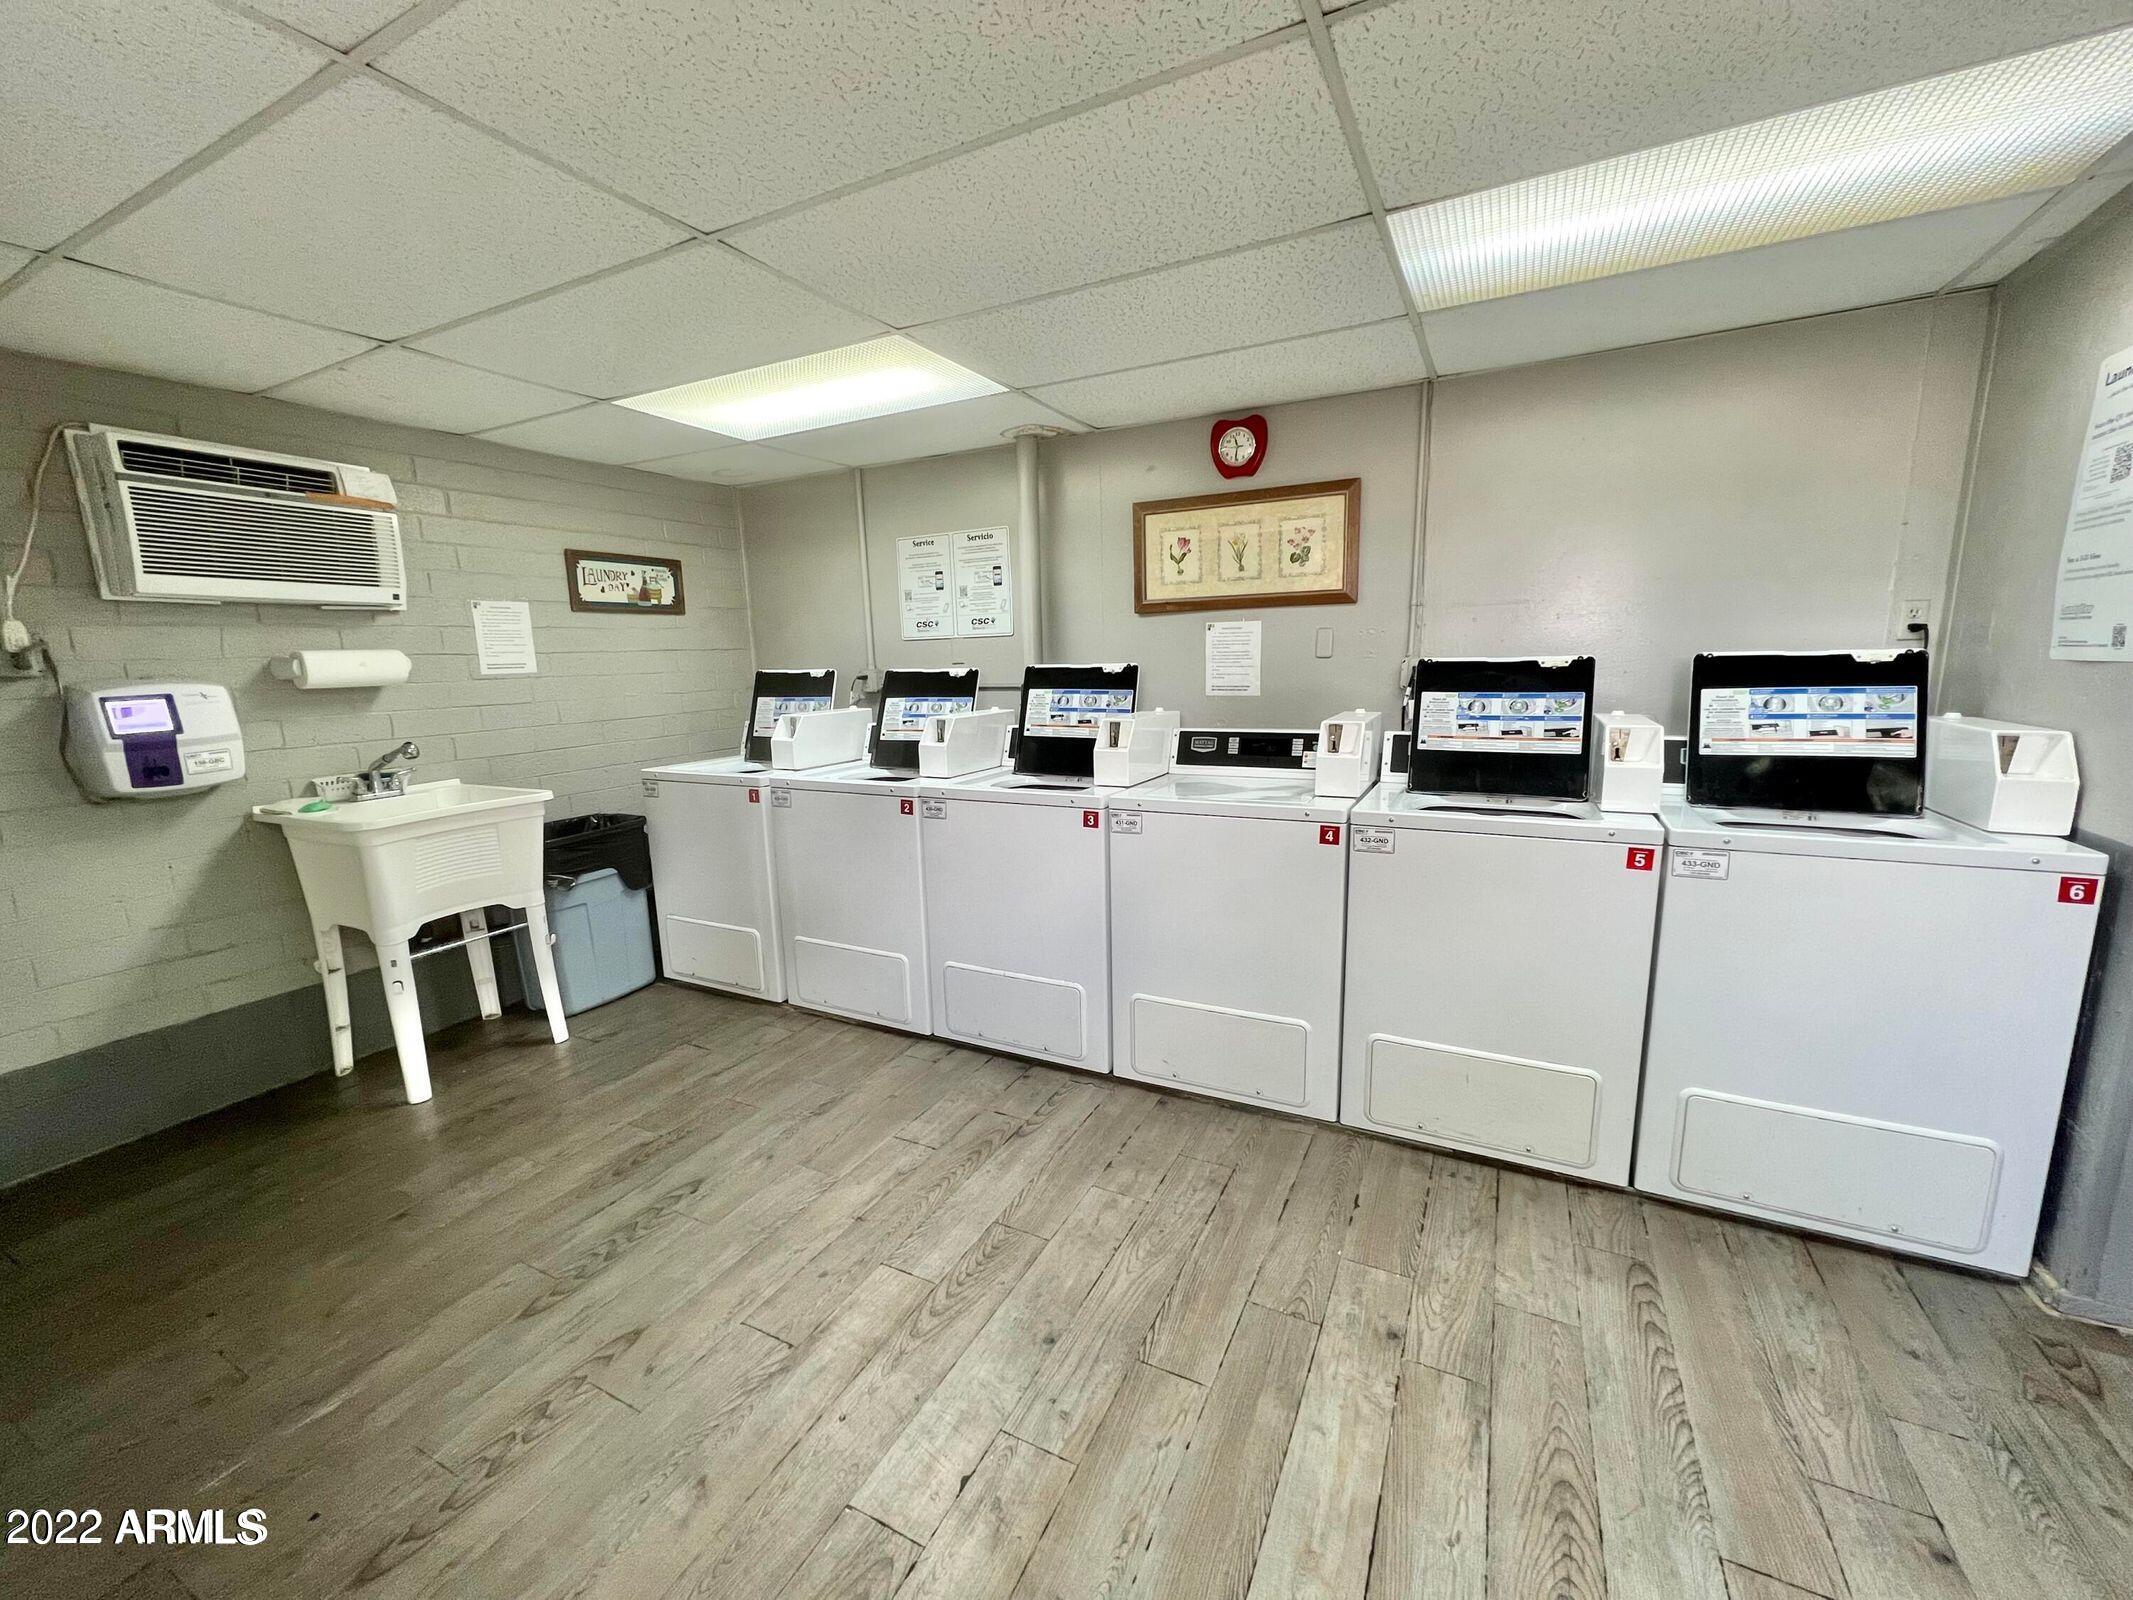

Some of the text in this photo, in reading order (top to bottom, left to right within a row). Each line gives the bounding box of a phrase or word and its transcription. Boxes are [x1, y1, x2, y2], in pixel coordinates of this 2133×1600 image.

[966, 533, 994, 542] Servicio
[912, 539, 935, 548] Service
[582, 566, 628, 586] LAUNDRY
[916, 620, 934, 628] CSC
[971, 617, 990, 626] CSC
[904, 803, 910, 813] 2
[1087, 815, 1095, 826] 3
[1325, 830, 1334, 842] 4
[1634, 853, 1646, 867] 5
[1681, 860, 1721, 869] 433-GND
[2069, 884, 2085, 901] 6
